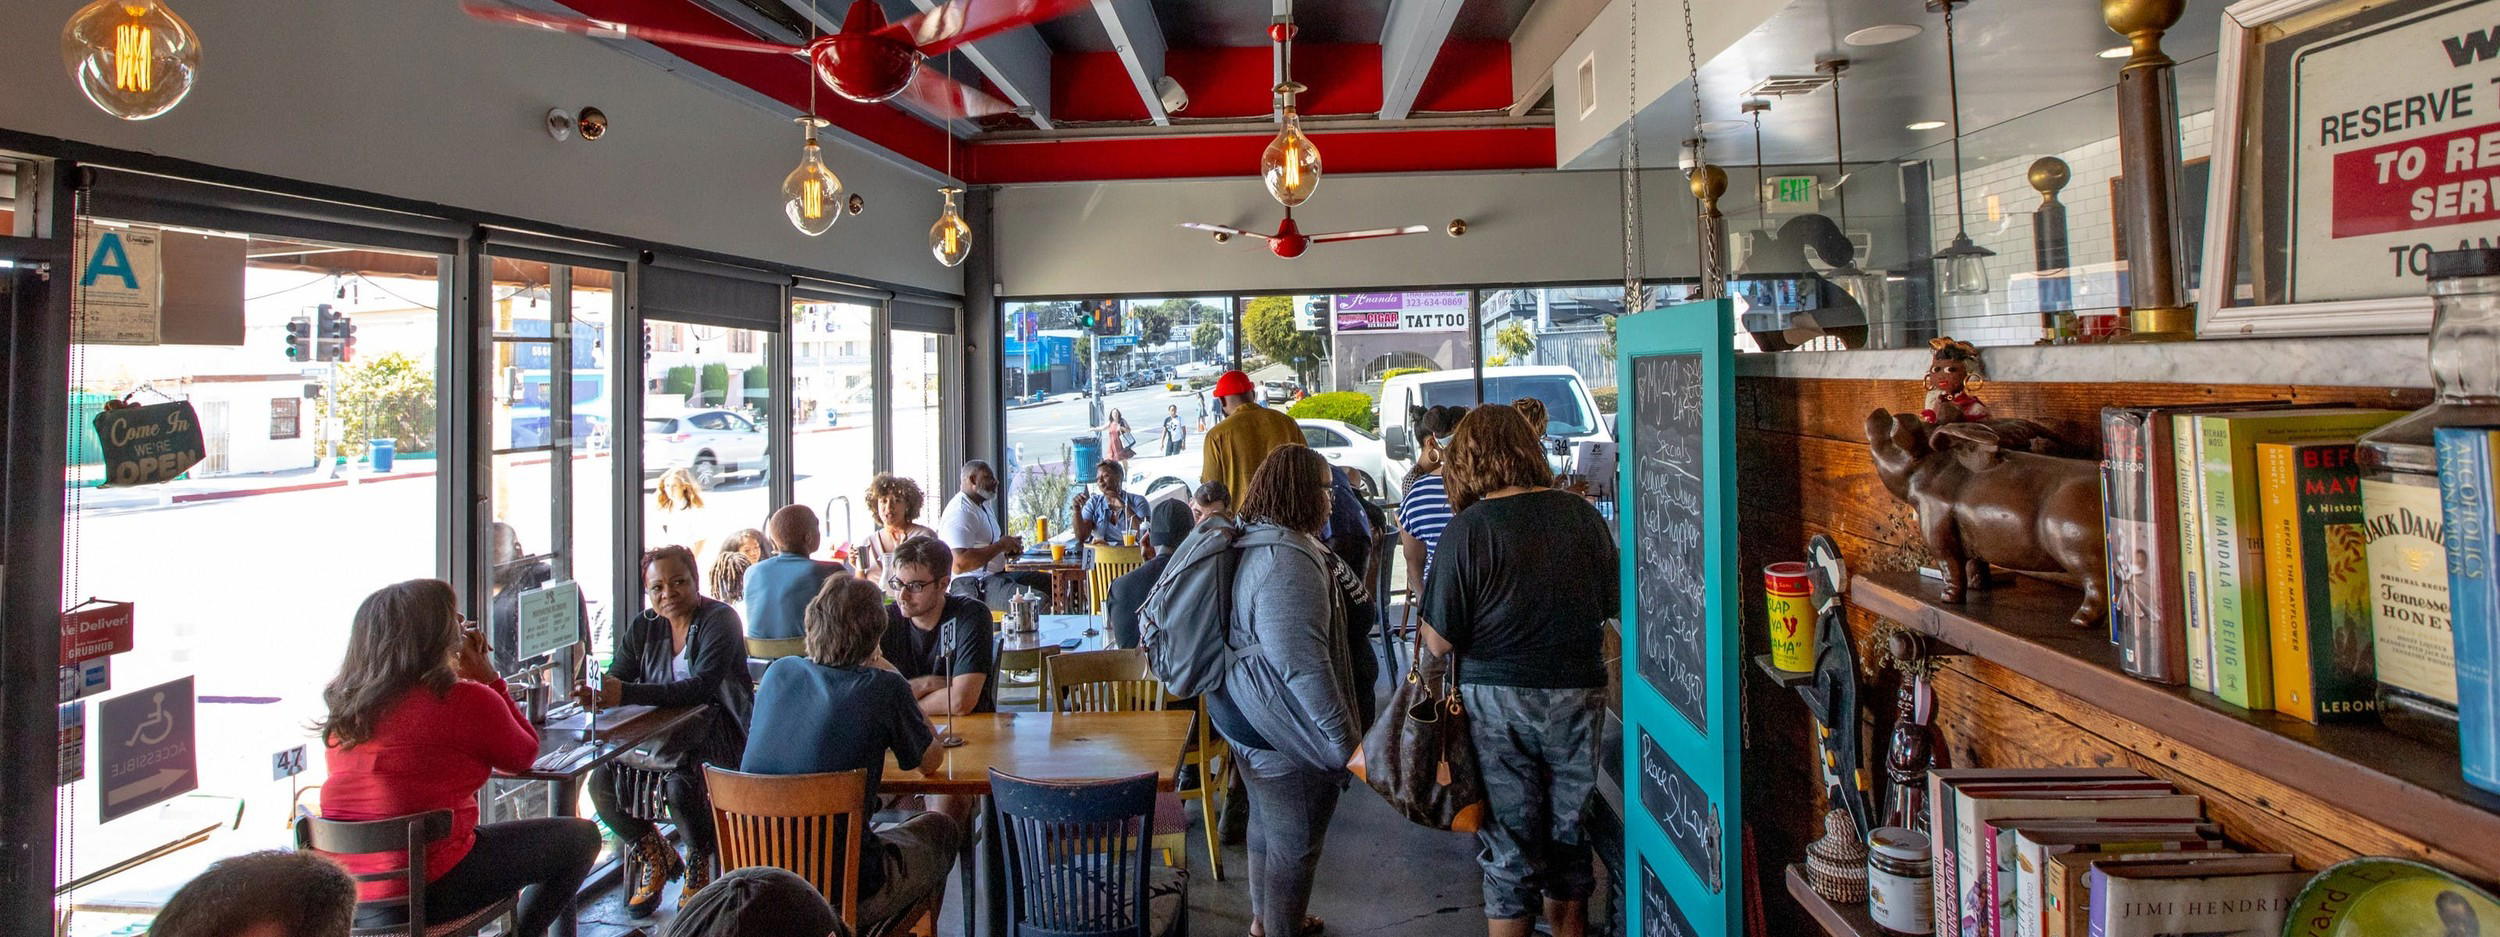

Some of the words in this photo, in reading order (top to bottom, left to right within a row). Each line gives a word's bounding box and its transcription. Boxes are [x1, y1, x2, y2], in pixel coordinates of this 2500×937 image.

[2321, 83, 2473, 147] RESERVE
[2374, 146, 2427, 184] TO
[1779, 178, 1810, 202] EXIT
[79, 232, 140, 289] A
[2389, 243, 2432, 277] TO
[1367, 313, 1397, 323] CIGAR
[1405, 314, 1465, 328] TATTOO
[111, 418, 160, 447] Come
[166, 410, 190, 434] In
[134, 440, 172, 456] WE'RE
[1555, 440, 1568, 452] 34
[116, 449, 196, 484] OPEN
[2305, 476, 2359, 496] MAY
[2214, 490, 2226, 510] THE
[2307, 503, 2316, 513] A
[2439, 440, 2463, 575] ANONYMOUS
[2456, 440, 2483, 579] ALCOHOLICS
[2363, 512, 2400, 545] JACK
[2215, 514, 2233, 589] MANDALA
[1768, 597, 1790, 616] SLAP
[2222, 597, 2233, 611] OF
[79, 613, 129, 633] Deliver!
[2288, 587, 2300, 653] MAYFLOWER
[944, 621, 954, 645] 60
[2222, 618, 2238, 668] BEING
[68, 641, 115, 660] GRUBHUB
[588, 659, 600, 681] 32
[277, 746, 303, 770] 47
[1934, 855, 1944, 892] italian
[2123, 902, 2173, 919] JIMI
